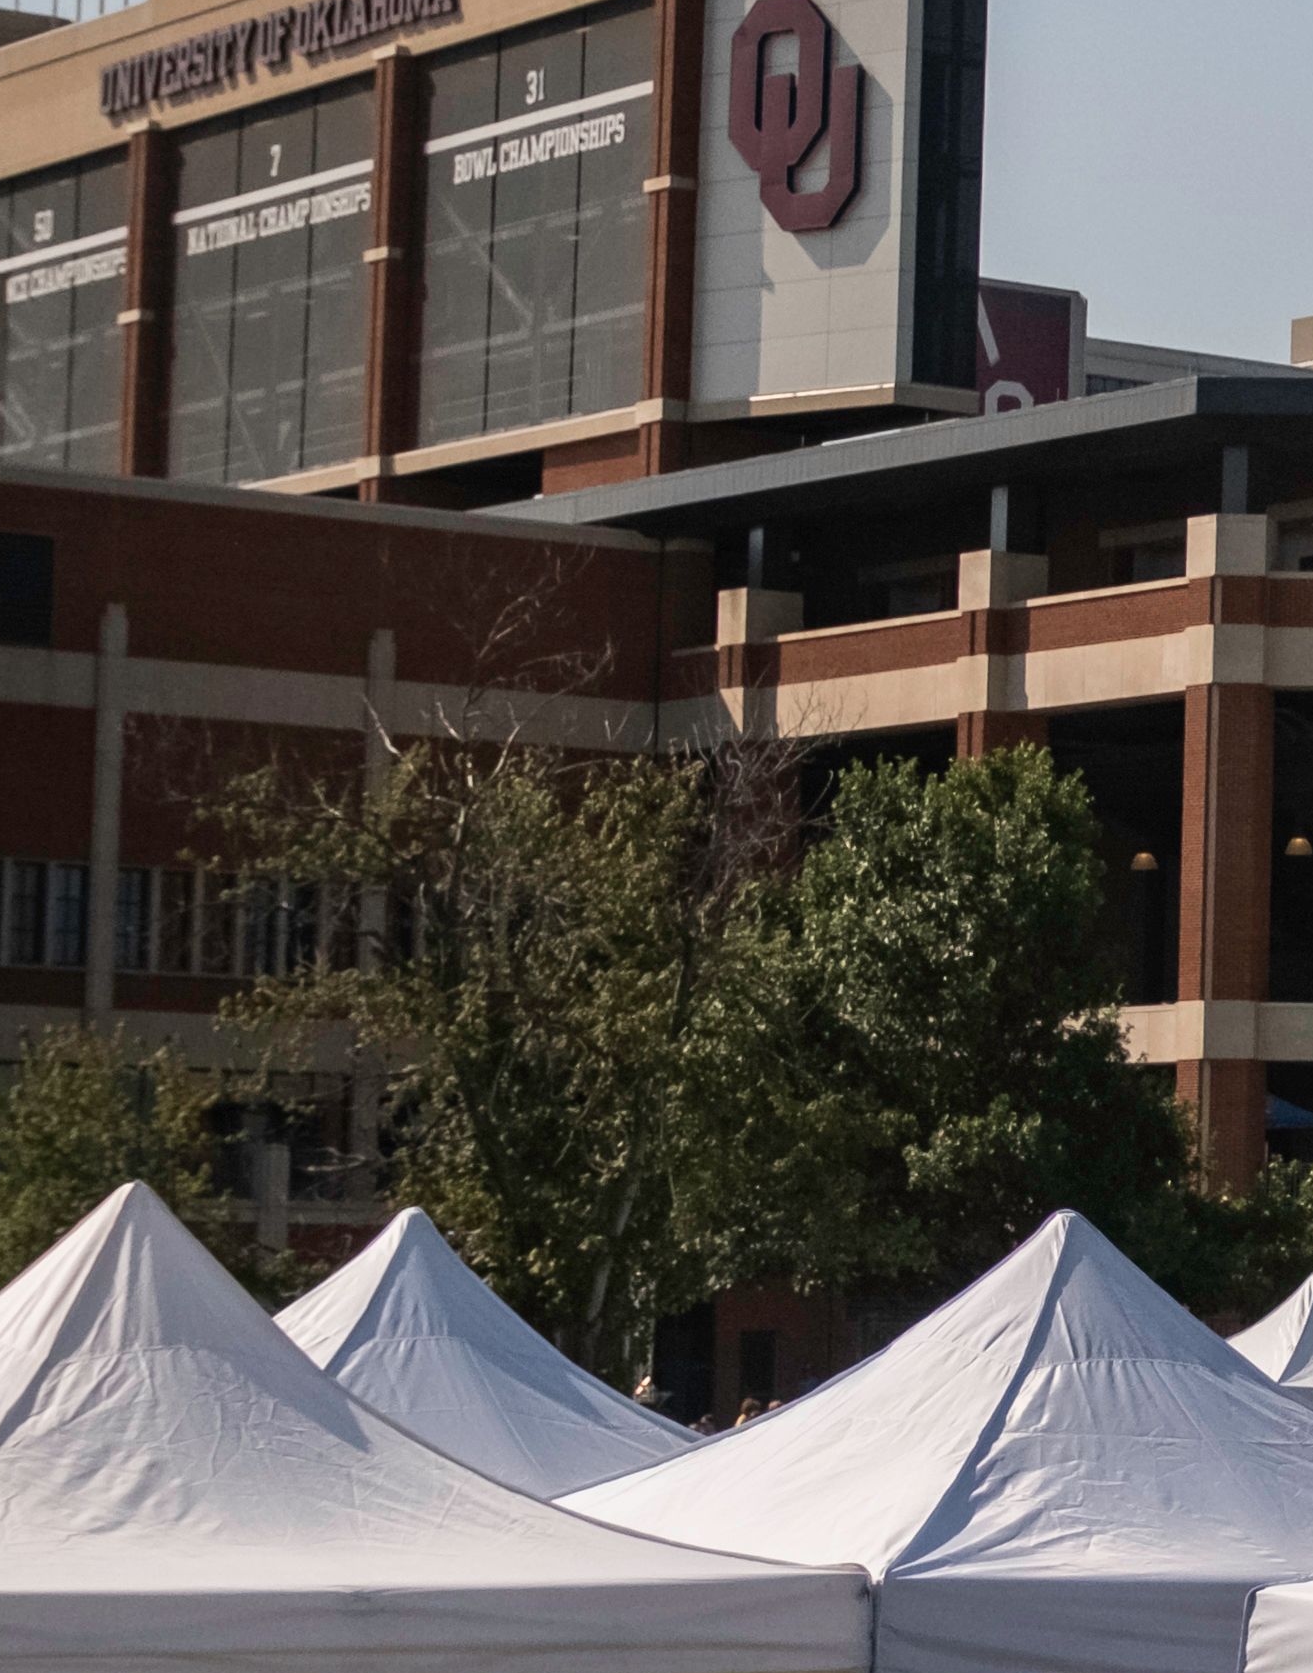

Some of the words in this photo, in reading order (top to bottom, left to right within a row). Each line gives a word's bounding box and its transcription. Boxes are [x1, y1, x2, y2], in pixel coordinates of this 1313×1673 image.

[100, 18, 255, 114] UNIVERSITY
[255, 5, 294, 65] OF
[525, 68, 545, 105] 31
[269, 143, 281, 177] 7
[453, 147, 497, 185] BOWL
[499, 112, 626, 173] CHAMPIONSHIPS
[187, 210, 257, 256] NATIONAL
[258, 181, 372, 238] CHAMPIONSHIPS
